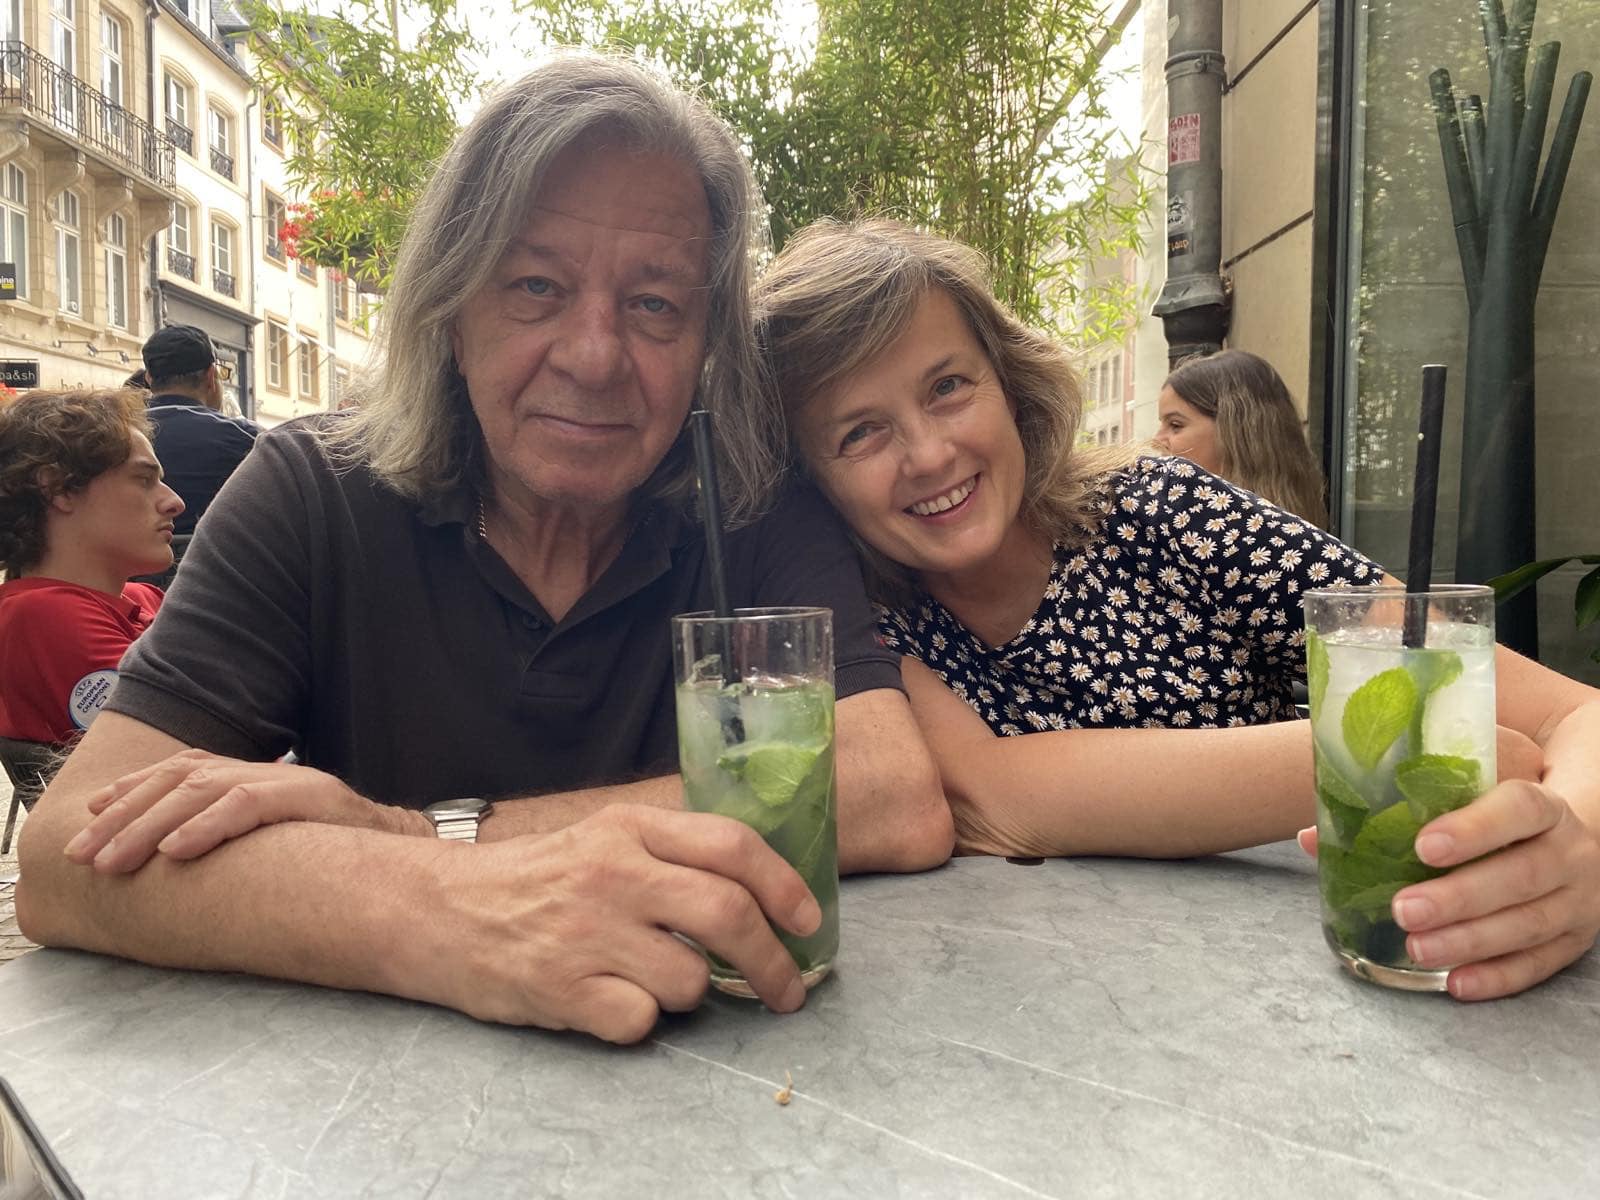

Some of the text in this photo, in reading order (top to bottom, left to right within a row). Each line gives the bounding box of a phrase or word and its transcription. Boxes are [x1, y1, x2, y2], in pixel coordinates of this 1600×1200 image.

[0, 275, 14, 284] ine
[77, 677, 105, 709] EUROPEAN
[83, 682, 110, 713] CHAMPIONS
